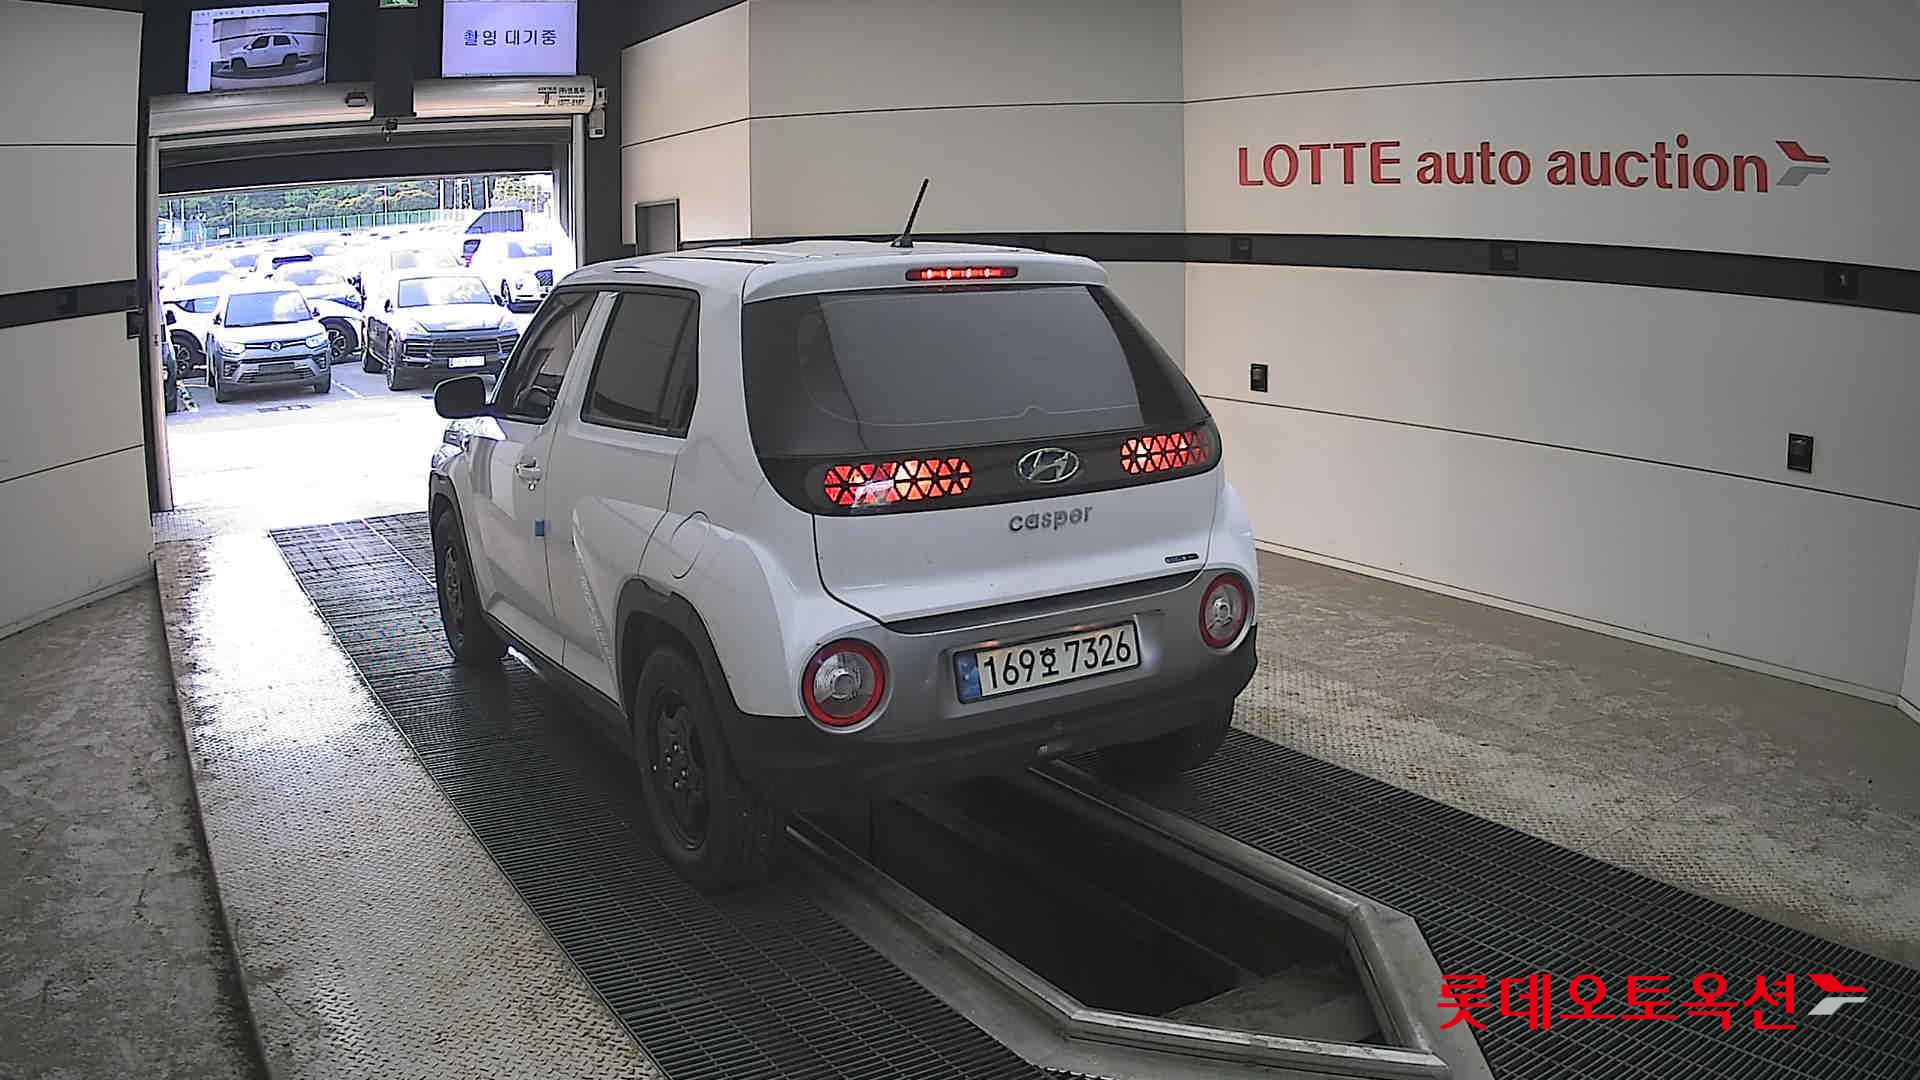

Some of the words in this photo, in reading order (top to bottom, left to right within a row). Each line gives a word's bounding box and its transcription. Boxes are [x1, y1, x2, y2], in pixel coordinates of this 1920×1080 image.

[505, 29, 557, 47] 대기중
[1238, 141, 1401, 188] LOTTE
[1416, 142, 1531, 185] auto
[1547, 133, 1769, 193] auction
[1008, 506, 1094, 532] casper
[983, 646, 1060, 689] 169호
[1064, 630, 1132, 673] 7326
